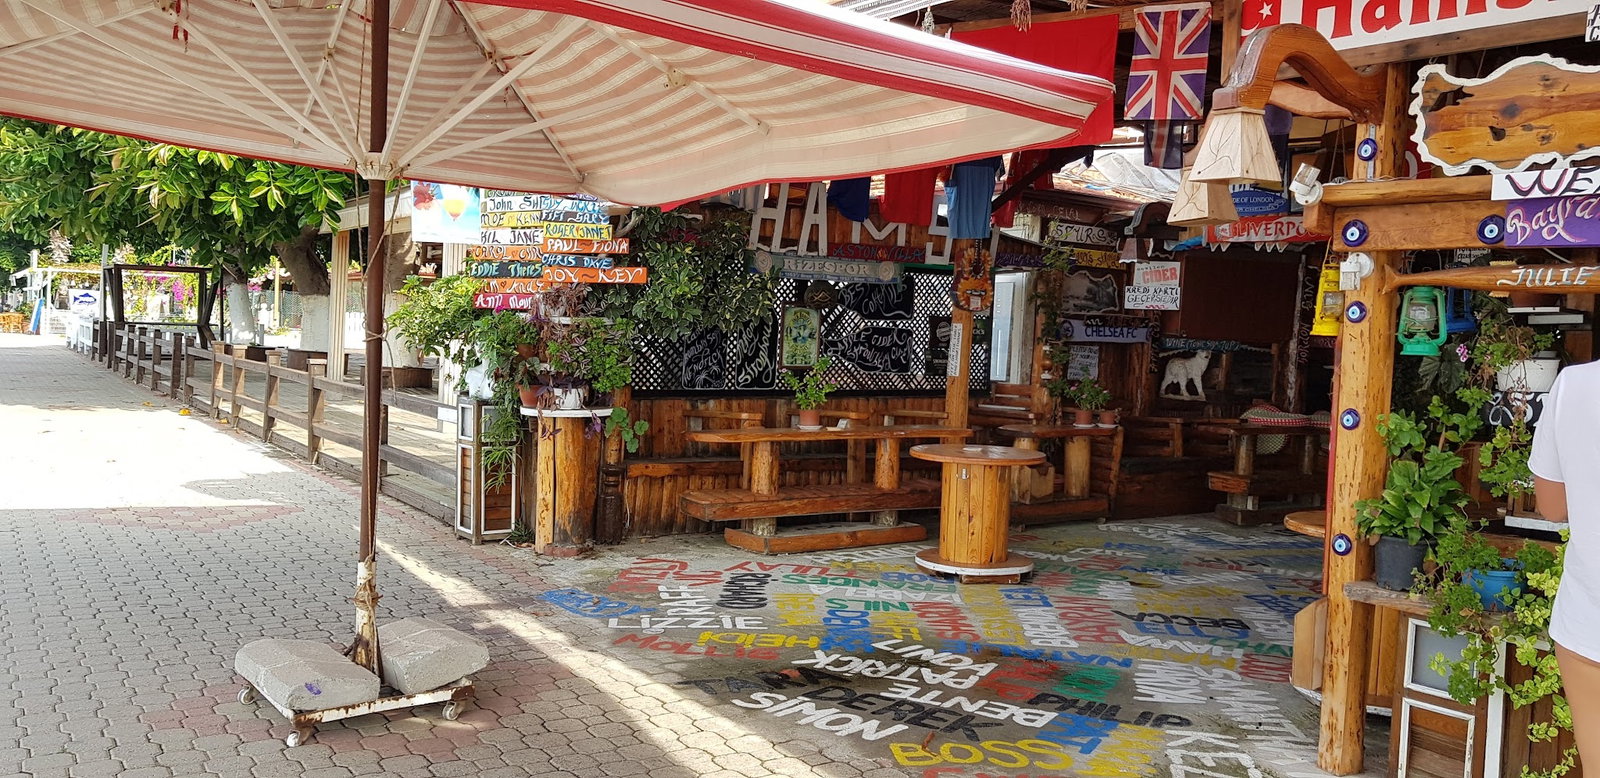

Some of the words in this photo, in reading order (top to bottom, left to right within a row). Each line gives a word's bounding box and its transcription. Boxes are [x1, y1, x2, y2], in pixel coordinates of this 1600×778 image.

[1505, 165, 1600, 196] WE
[490, 198, 514, 211] John
[1506, 196, 1600, 245] Bayra
[510, 230, 544, 244] JANE
[545, 223, 576, 237] ROGER
[580, 226, 611, 239] JANET
[475, 246, 512, 260] CAROL
[519, 246, 543, 259] CHR
[547, 239, 582, 252] PAUL
[471, 262, 500, 277] EDDIE
[542, 254, 576, 267] CHRIS
[544, 268, 580, 282] JOY
[1496, 265, 1600, 288] JULIE
[1084, 325, 1125, 338] CHELSEA
[1126, 327, 1138, 338] FC
[781, 574, 956, 593] FRANCES
[657, 585, 716, 617] RAFF
[825, 598, 910, 612] NILS
[1000, 587, 1054, 607] LEA
[909, 601, 981, 641] SHARON
[1012, 606, 1080, 649] BRENDA
[1111, 609, 1251, 630] BECCA
[798, 685, 1004, 741] DEREK
[880, 681, 1059, 728] BENTE
[1028, 692, 1196, 728] PHILIP
[890, 739, 1074, 770] BOSS
